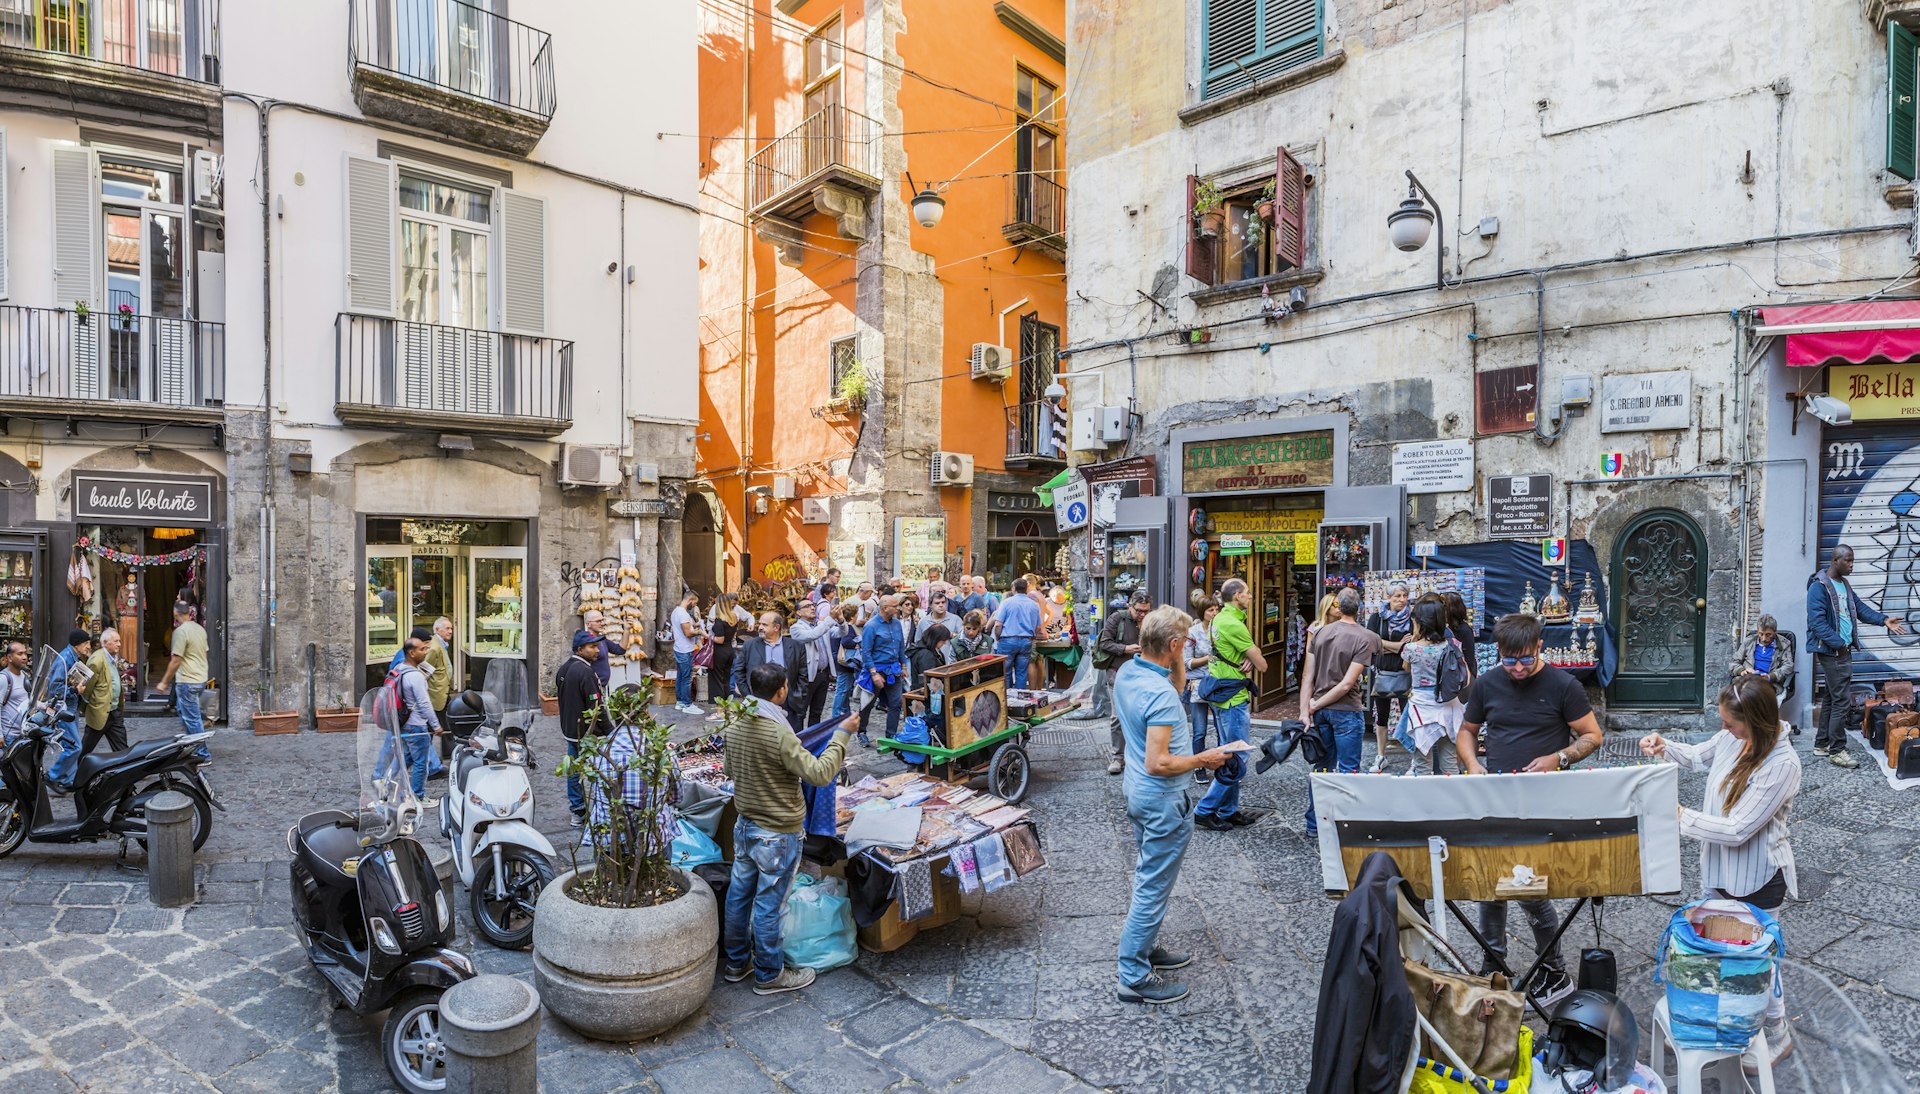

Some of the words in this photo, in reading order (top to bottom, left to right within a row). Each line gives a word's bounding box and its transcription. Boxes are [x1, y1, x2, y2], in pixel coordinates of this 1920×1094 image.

[1640, 380, 1653, 390] VIA
[1848, 372, 1914, 401] Bella
[1610, 396, 1651, 410] S.GREGORIO
[1655, 394, 1683, 408] ARMENO
[1403, 450, 1434, 458] ROBERTO
[1436, 448, 1464, 456] BRACCO
[1247, 465, 1266, 475] AL
[89, 486, 134, 508] baule
[136, 488, 197, 511] Volante
[622, 502, 644, 512] SENSO
[645, 502, 664, 512] UNICO
[1217, 520, 1260, 531] TOMBOLA
